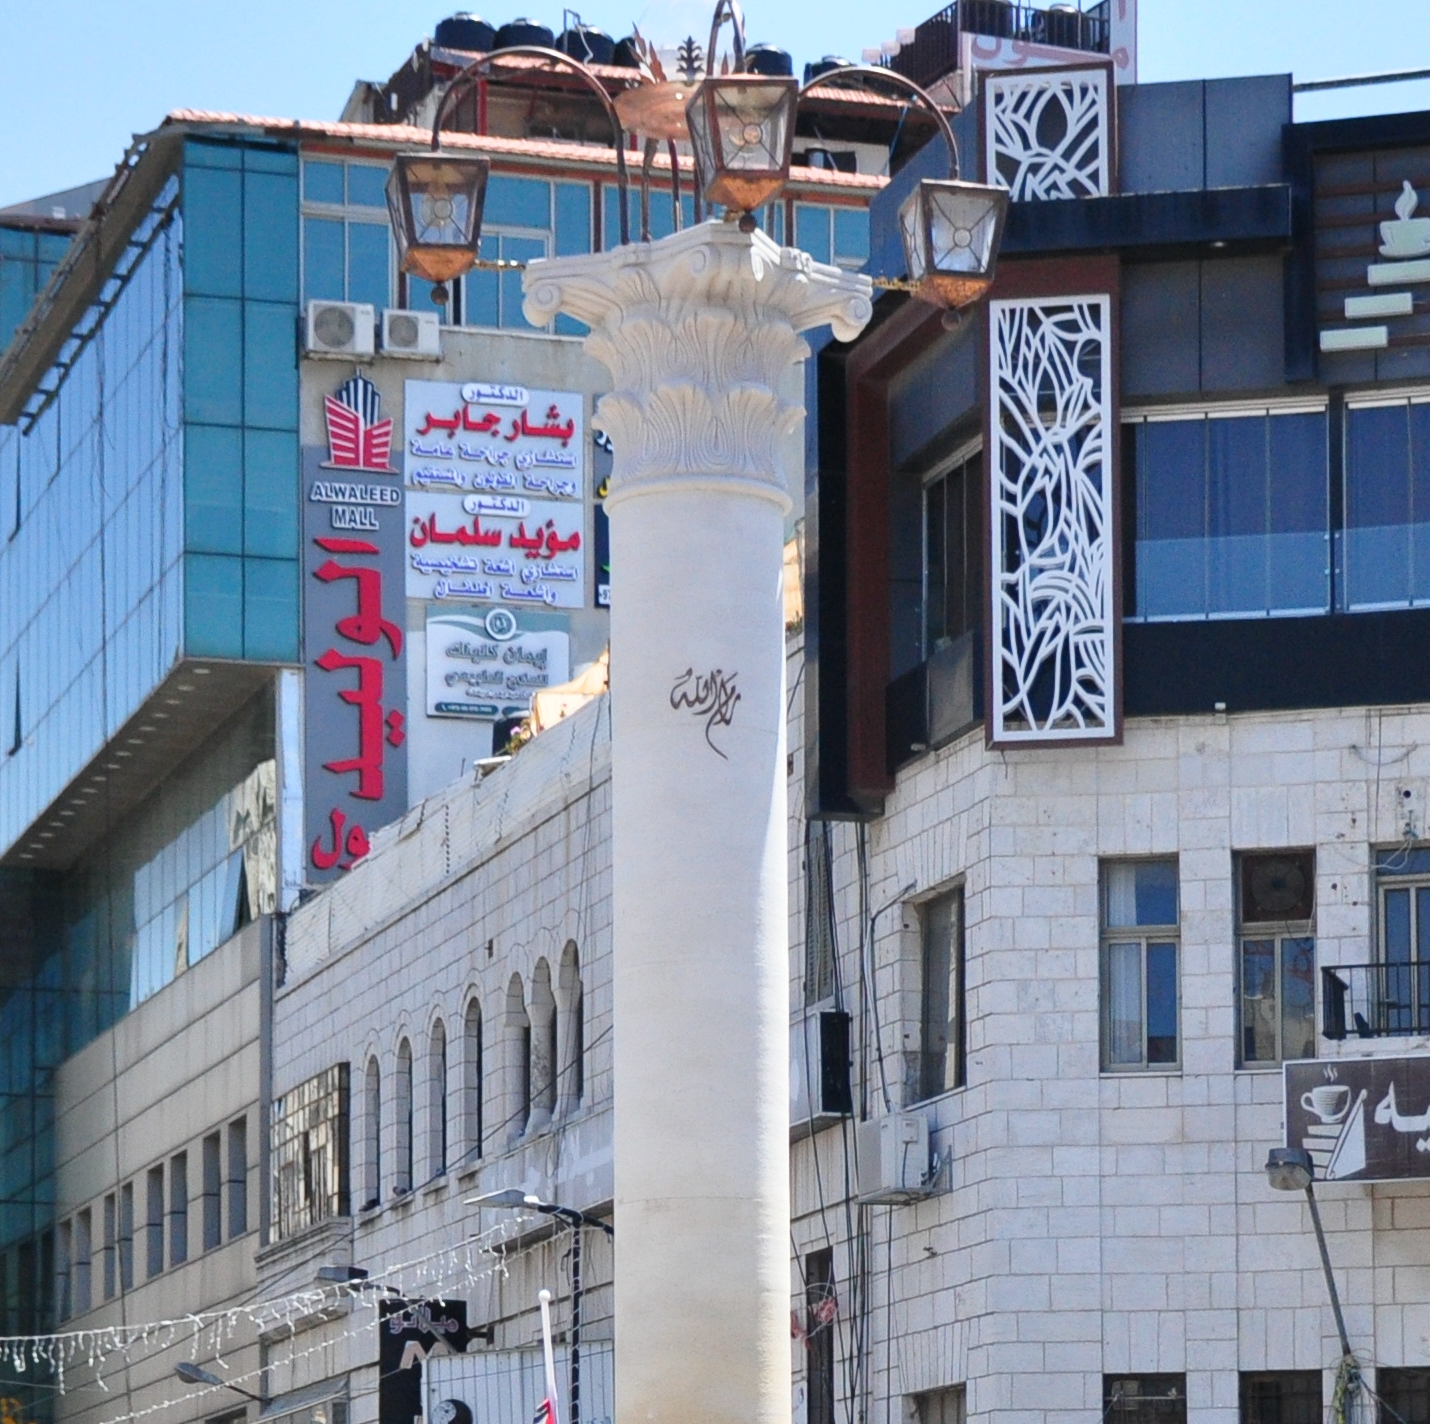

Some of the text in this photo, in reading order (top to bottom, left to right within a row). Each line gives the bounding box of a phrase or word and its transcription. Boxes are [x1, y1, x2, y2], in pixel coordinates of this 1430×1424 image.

[416, 402, 501, 439] جابر
[504, 404, 575, 447] بشار
[310, 481, 401, 505] ALWALEED
[332, 505, 379, 530] MALL
[410, 512, 581, 560] مؤيد سلمان
[313, 537, 405, 801] الوليد
[312, 808, 370, 870] ول
